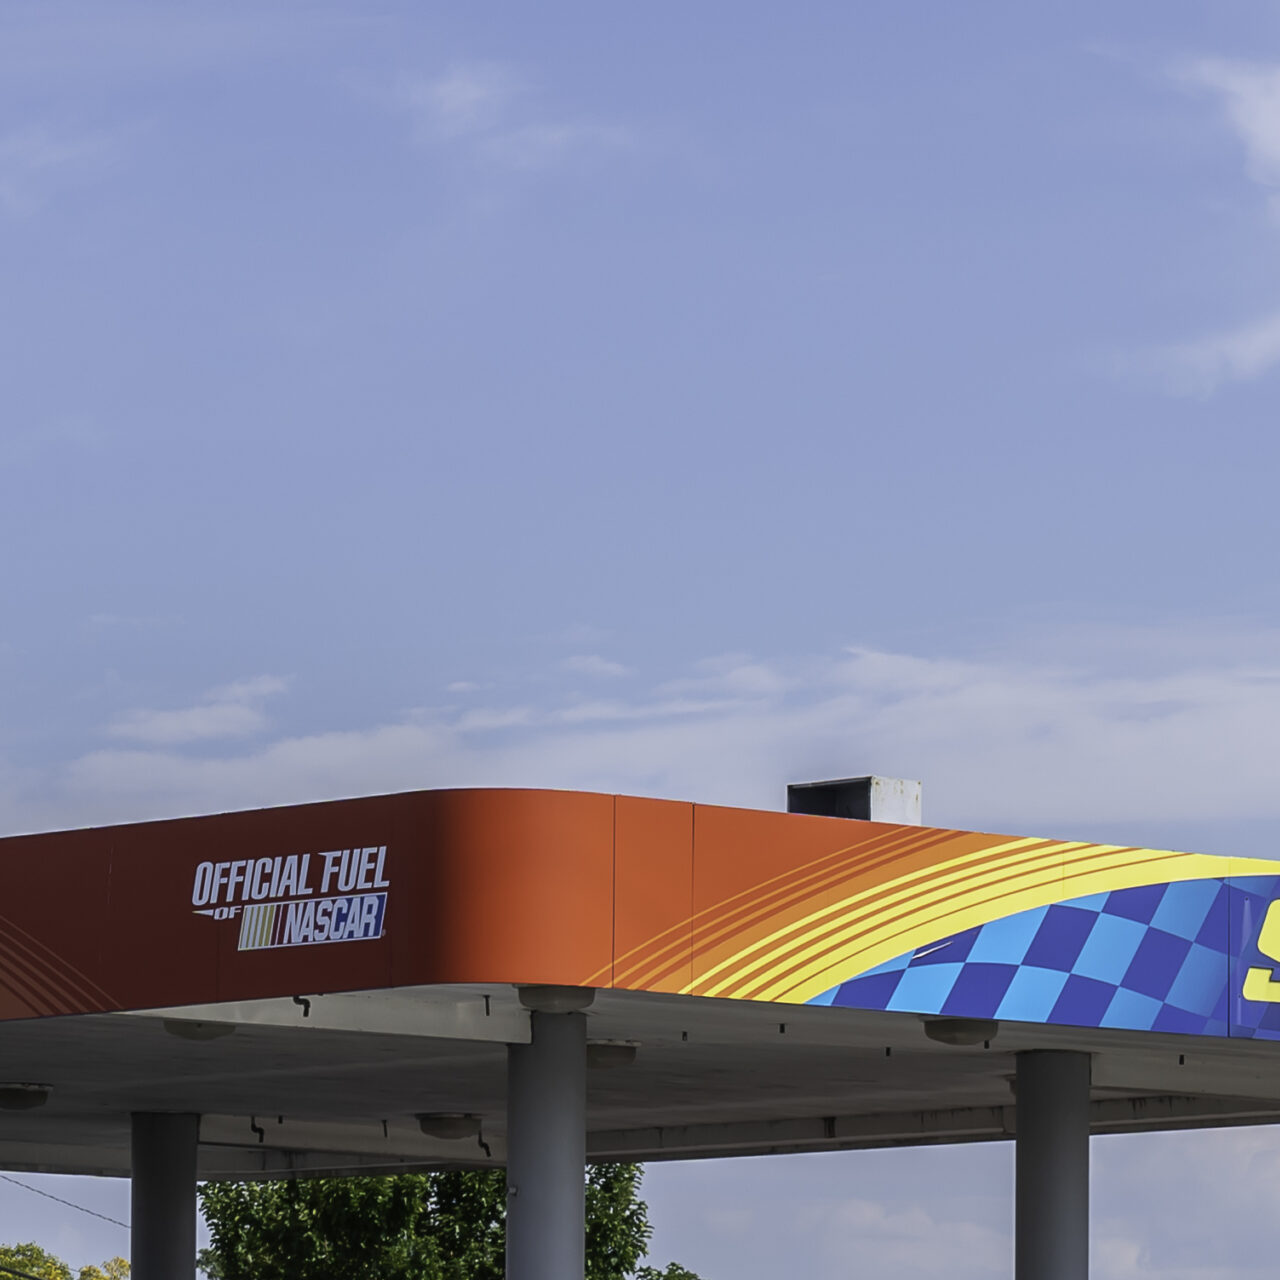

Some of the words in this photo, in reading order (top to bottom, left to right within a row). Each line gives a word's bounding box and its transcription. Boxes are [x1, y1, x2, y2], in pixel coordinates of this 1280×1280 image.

[191, 853, 314, 906] OFFICIAL
[318, 846, 390, 892] FUEL
[213, 906, 241, 920] OF
[283, 894, 379, 944] NASCAR
